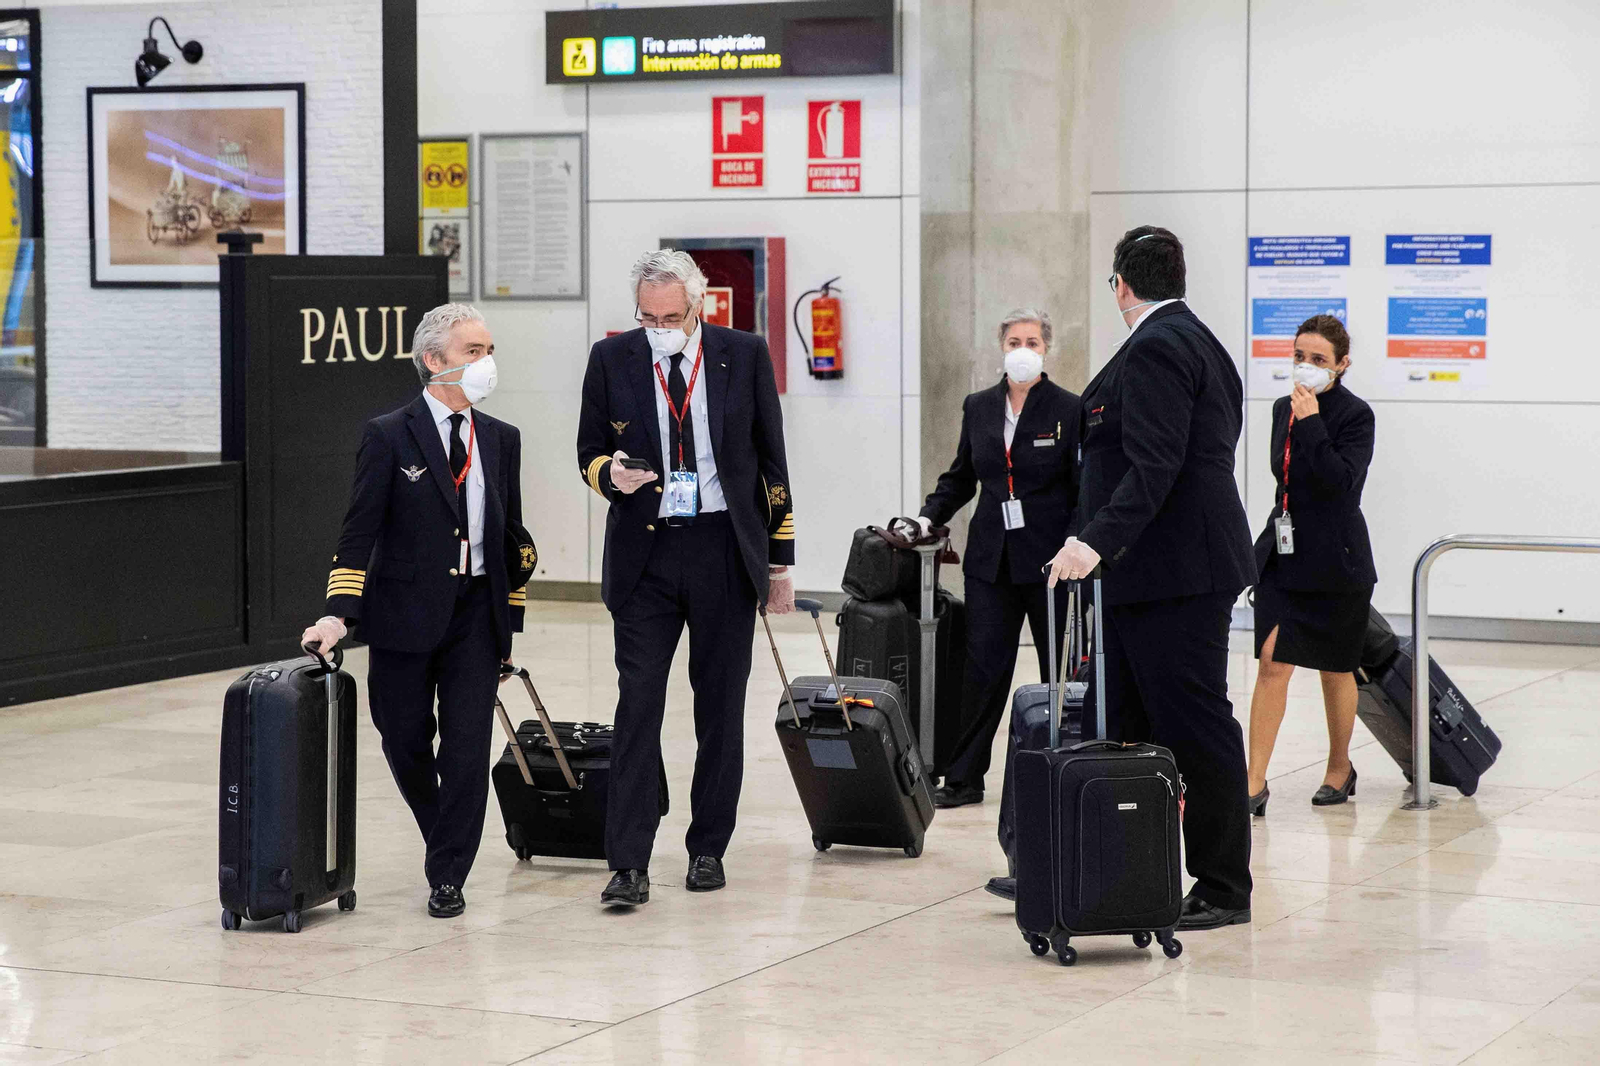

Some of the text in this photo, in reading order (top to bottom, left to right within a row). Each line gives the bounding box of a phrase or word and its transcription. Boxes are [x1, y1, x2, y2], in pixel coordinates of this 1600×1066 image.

[642, 34, 766, 54] Fire arms registration
[642, 52, 781, 72] Intervención de armas
[300, 306, 414, 364] PAUL
